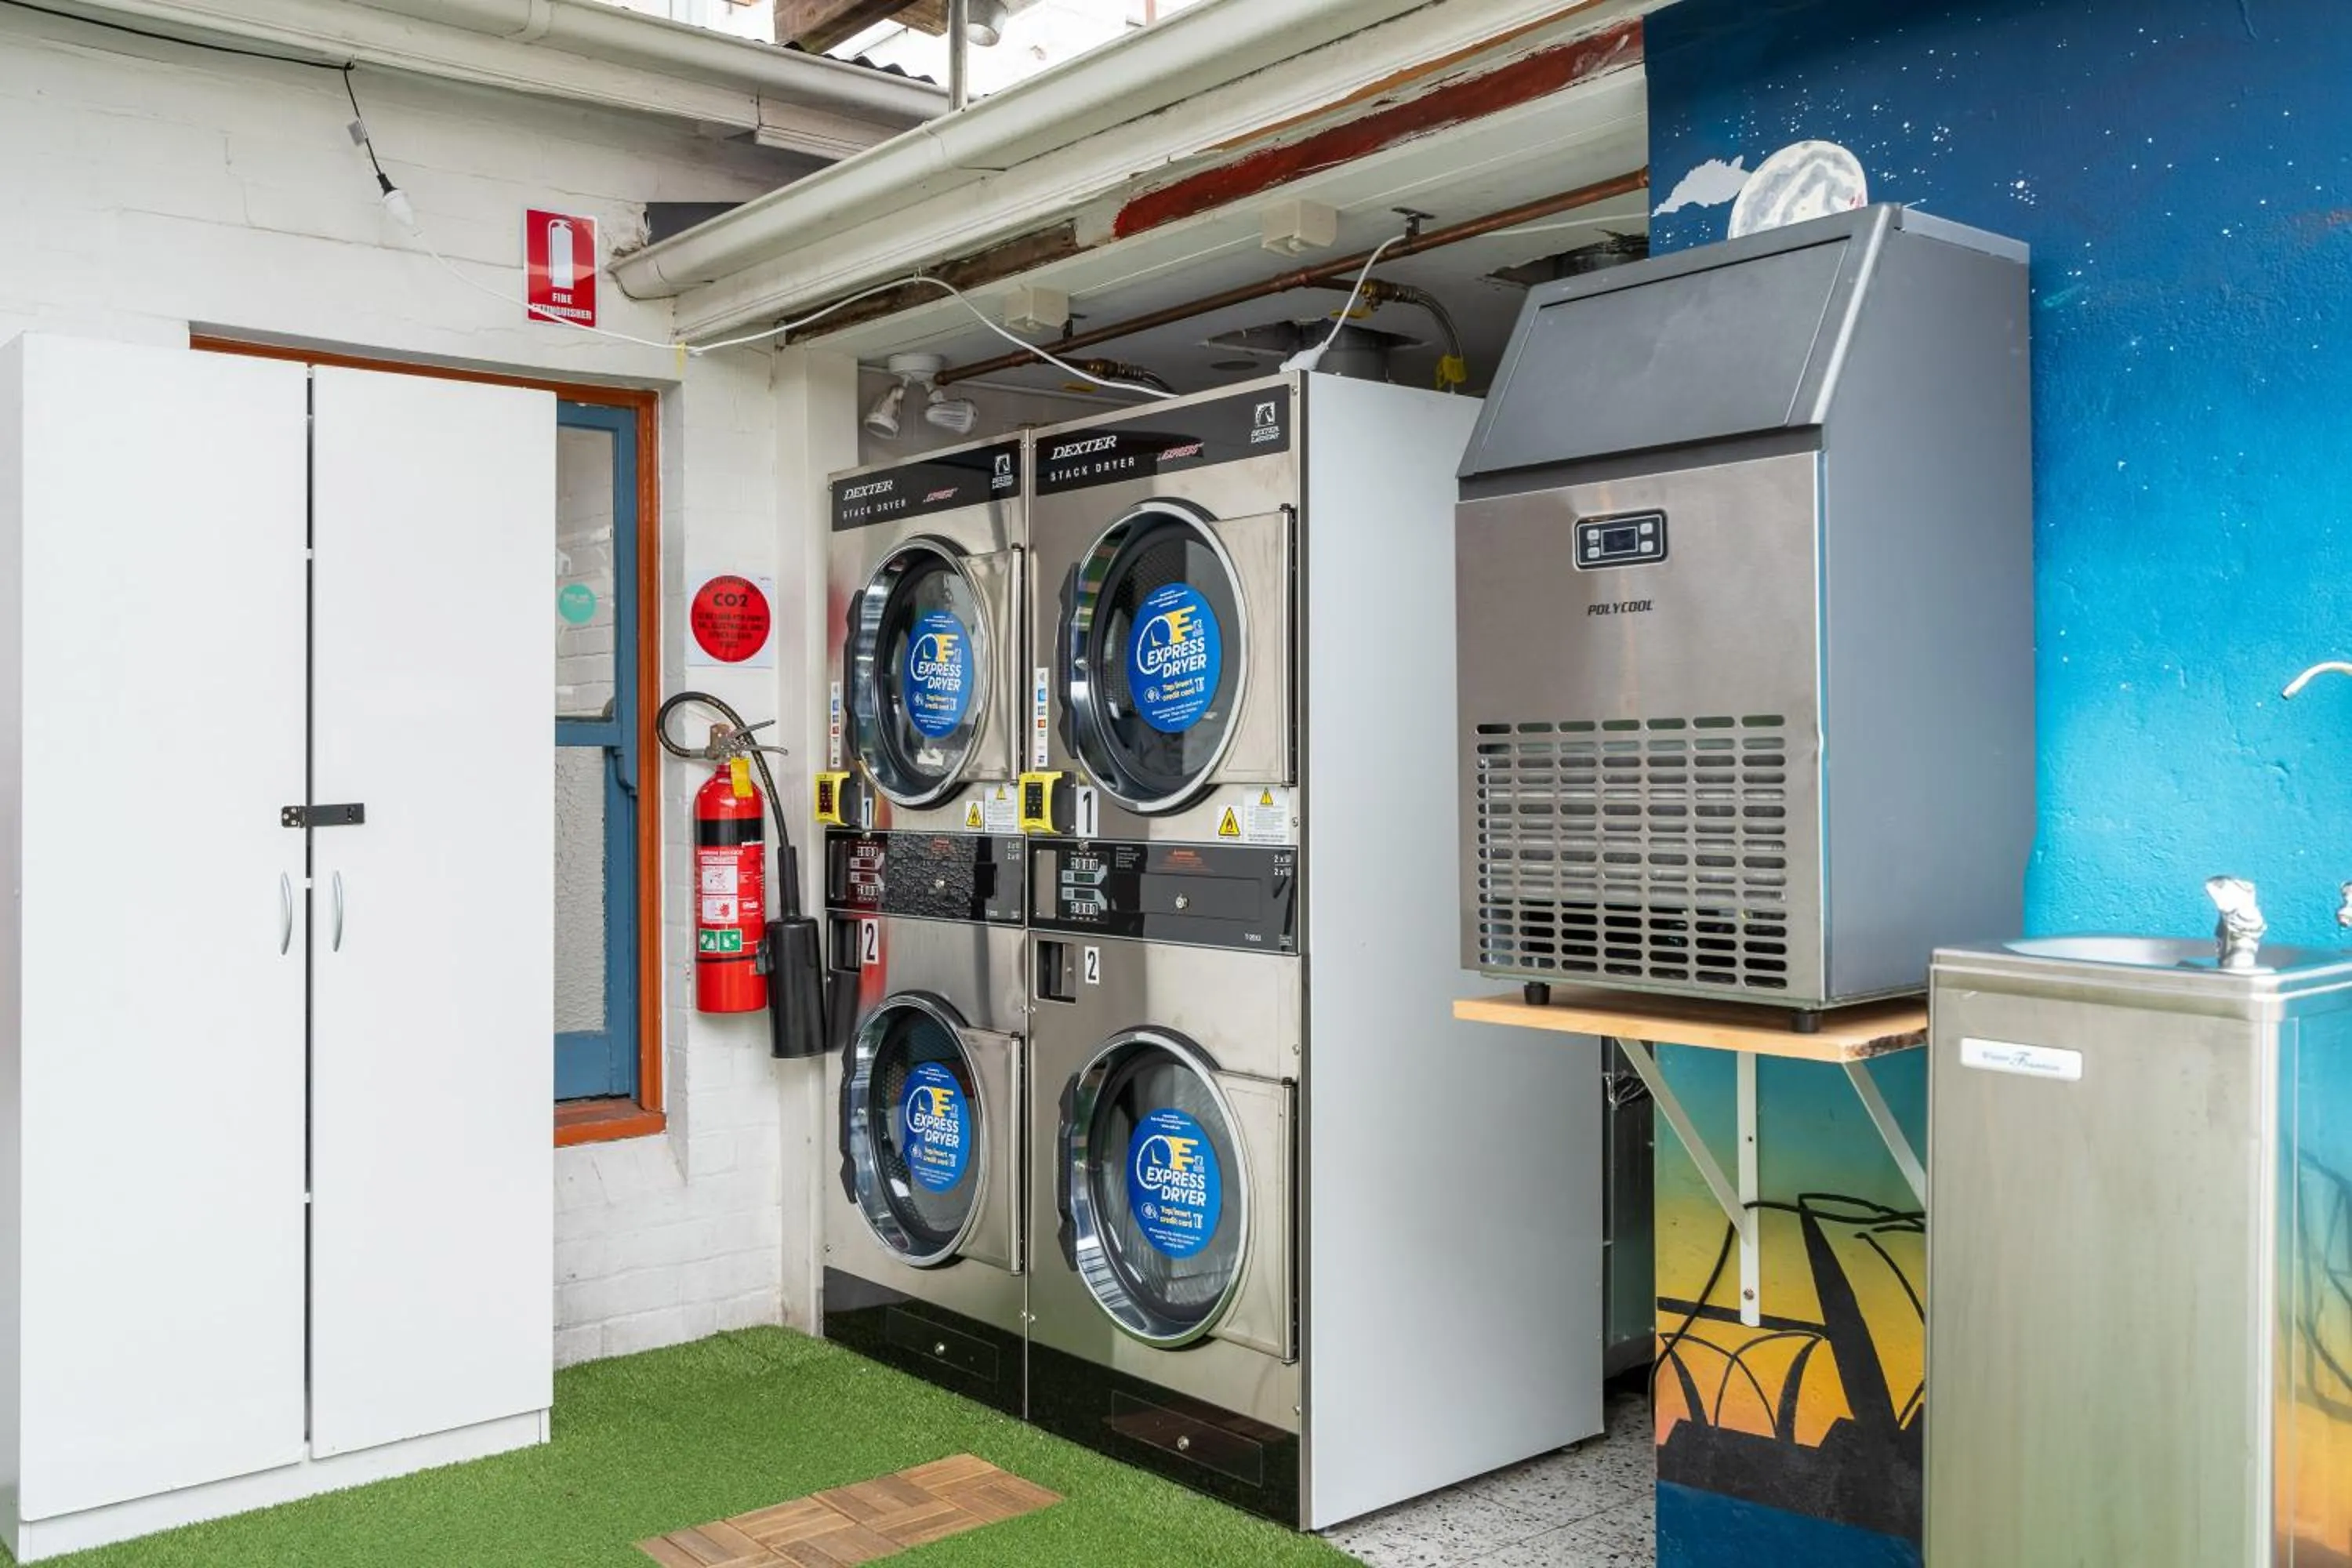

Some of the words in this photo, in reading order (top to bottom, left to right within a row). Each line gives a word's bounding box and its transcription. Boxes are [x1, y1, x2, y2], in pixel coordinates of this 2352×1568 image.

[552, 292, 573, 304] FIRE
[1050, 435, 1117, 461] DEXTER
[1050, 466, 1088, 482] STACK
[1095, 456, 1136, 474] DRYER
[844, 479, 894, 501] DEXTER
[843, 507, 872, 520] STACK
[877, 498, 906, 512] DRYER
[713, 593, 749, 608] CO2
[1588, 600, 1653, 615] POLYCOOL
[1147, 637, 1205, 666] EXPRESS
[917, 661, 962, 678] EXPRESS
[1163, 653, 1207, 678] DRYER
[927, 676, 961, 691] DRYER
[865, 800, 870, 829] 1
[1083, 790, 1092, 834] 1
[866, 923, 876, 960] 2
[1087, 950, 1097, 981] 2
[913, 1112, 960, 1134] EXPRESS
[924, 1130, 960, 1148] DRYER
[1146, 1166, 1206, 1190] EXPRESS
[1161, 1185, 1207, 1207] DRYER
